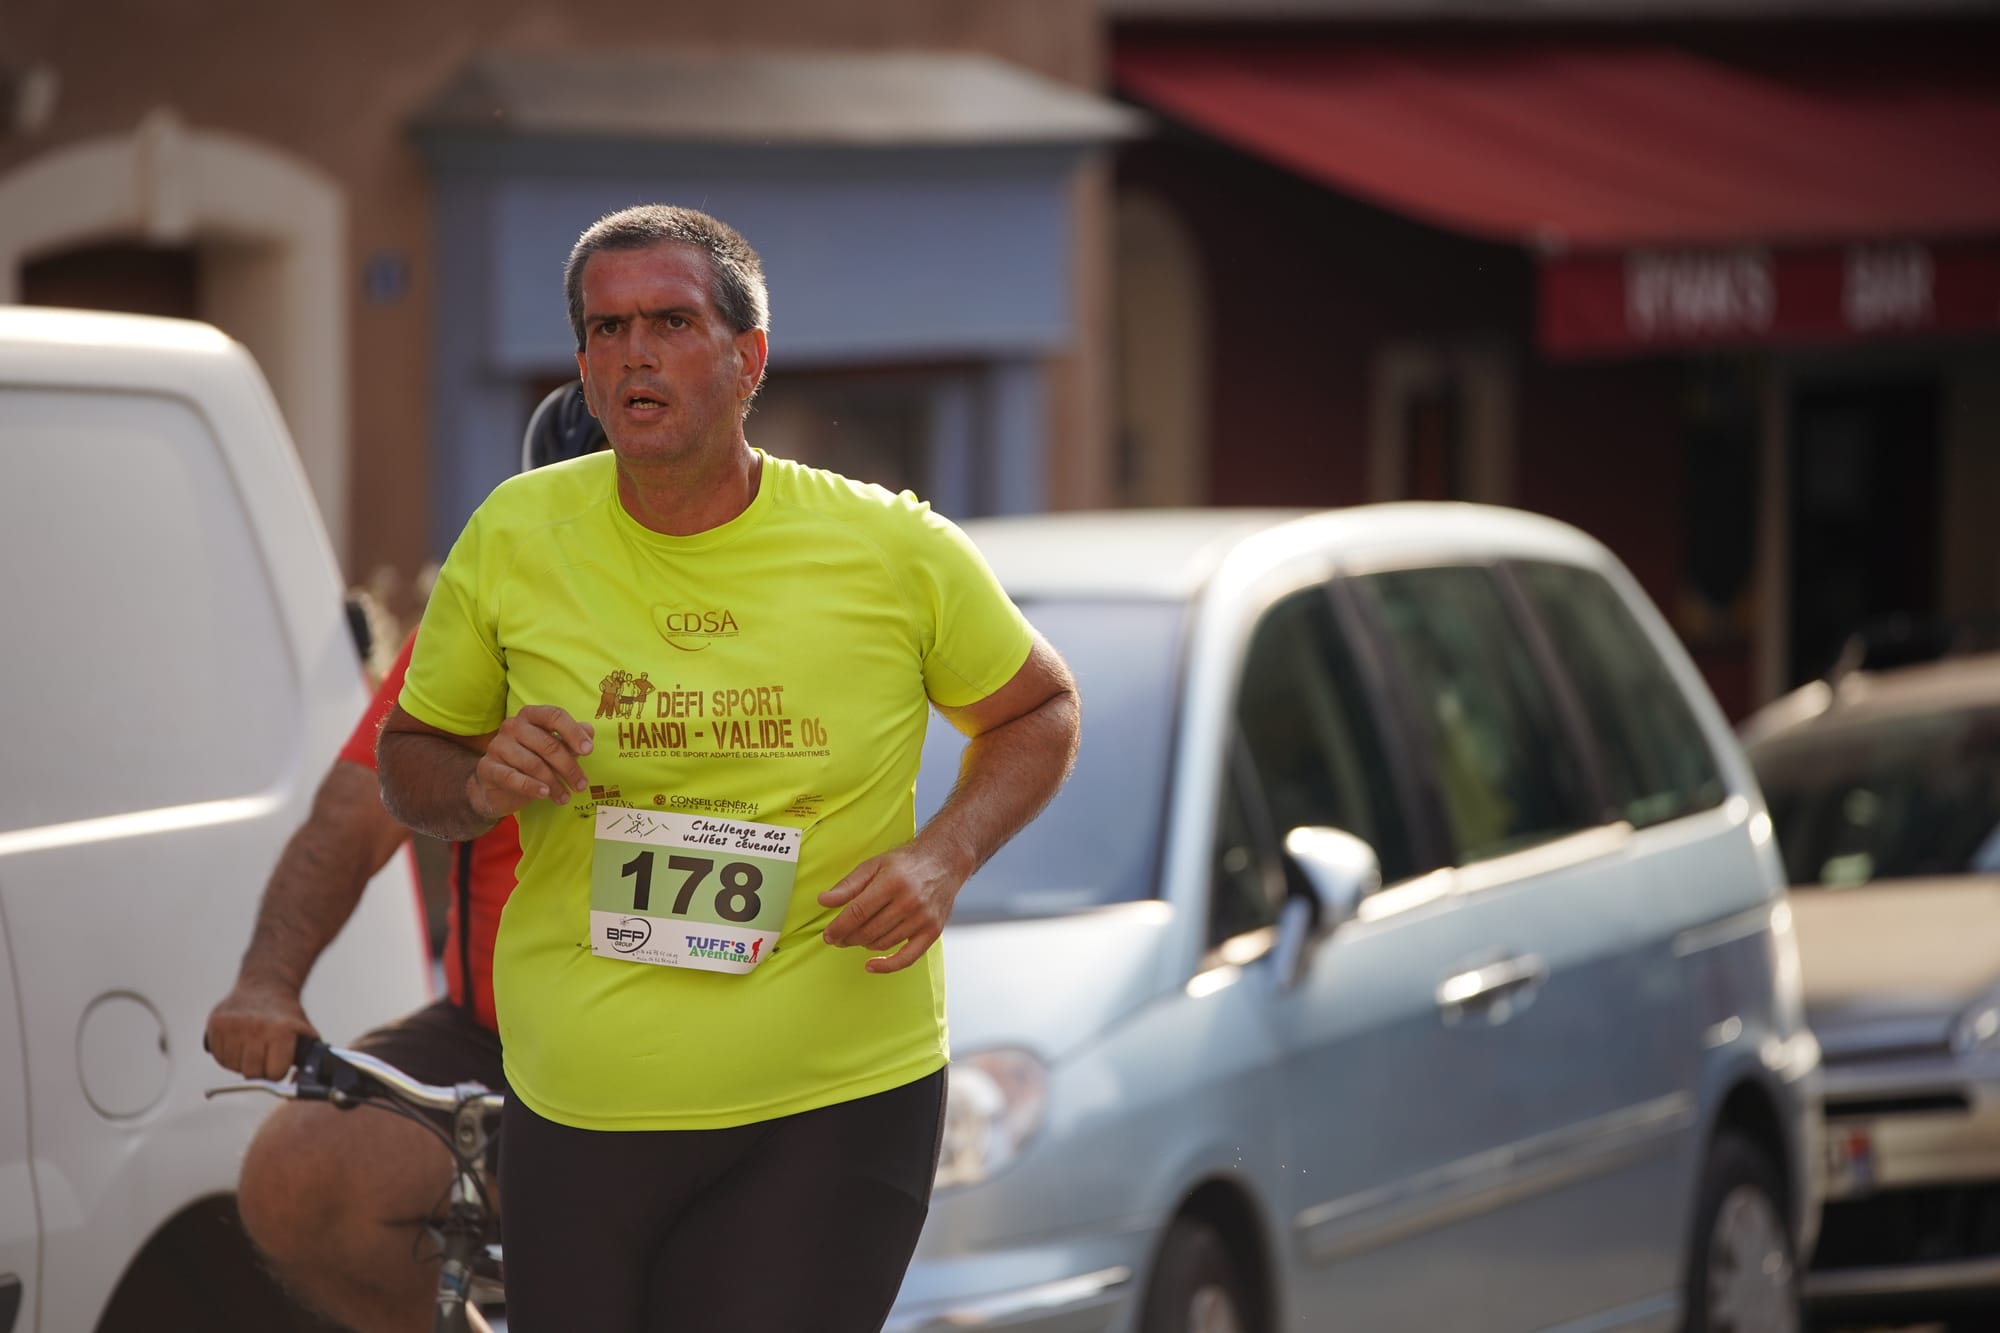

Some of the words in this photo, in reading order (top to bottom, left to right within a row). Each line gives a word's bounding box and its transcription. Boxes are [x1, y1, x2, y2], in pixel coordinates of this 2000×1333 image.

[666, 610, 739, 633] CDSA
[711, 685, 784, 718] SPORT
[617, 721, 688, 750] HANDI
[711, 718, 794, 750] VALIDE
[800, 717, 828, 748] 06
[618, 751, 640, 759] AVEC
[641, 750, 652, 758] LE
[682, 751, 709, 759] SPORT
[742, 751, 759, 759] DES
[759, 749, 831, 759] ALPES-MARITIMES
[670, 795, 713, 807] CONSEIL
[713, 798, 759, 811] GÉNÉRAL
[691, 820, 757, 840] Challenge
[763, 829, 787, 841] des
[682, 833, 728, 846] vallées
[735, 838, 791, 855] cévenoles
[620, 850, 764, 923] 178
[606, 927, 645, 943] BFP
[615, 940, 633, 948] GROUP
[685, 935, 746, 955] TUFF'S
[688, 945, 750, 963] Aventure
